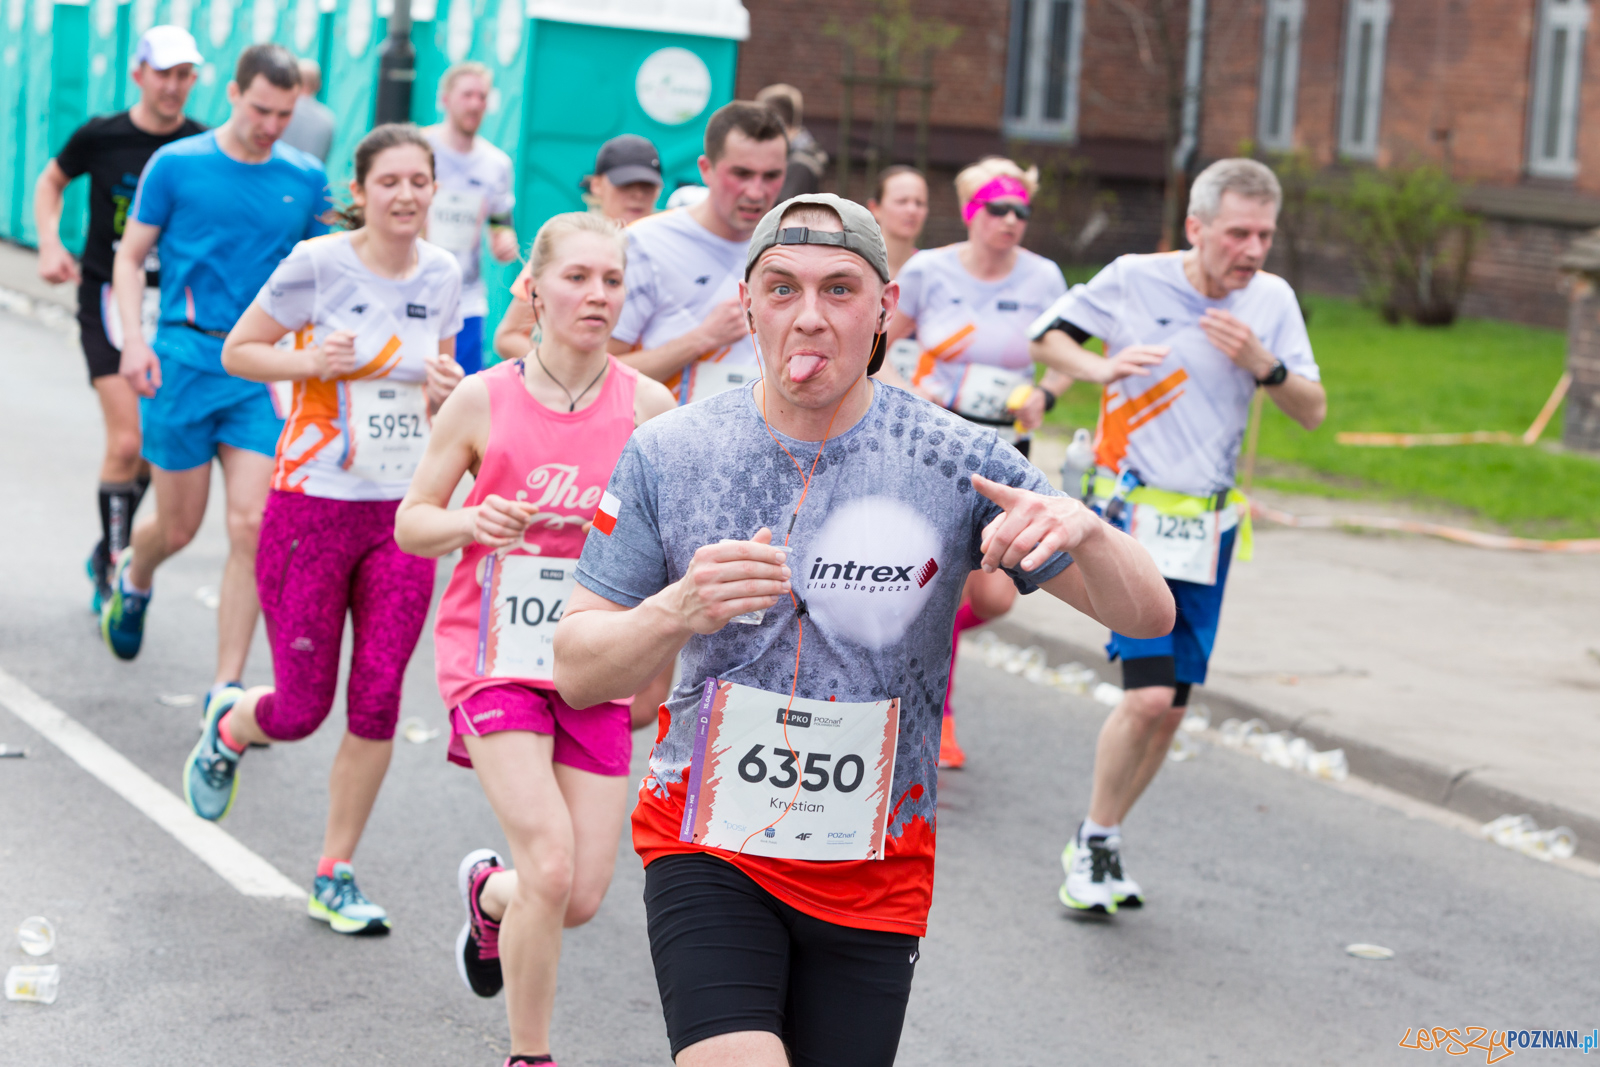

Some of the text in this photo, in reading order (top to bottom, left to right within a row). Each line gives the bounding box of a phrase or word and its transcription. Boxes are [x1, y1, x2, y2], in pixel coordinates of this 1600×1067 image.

[368, 414, 423, 439] 5952
[515, 462, 602, 510] The
[809, 557, 915, 582] intrex
[844, 582, 910, 593] biegacza
[791, 714, 809, 724] PKO
[737, 743, 865, 793] 6350
[769, 797, 825, 813] Krystian
